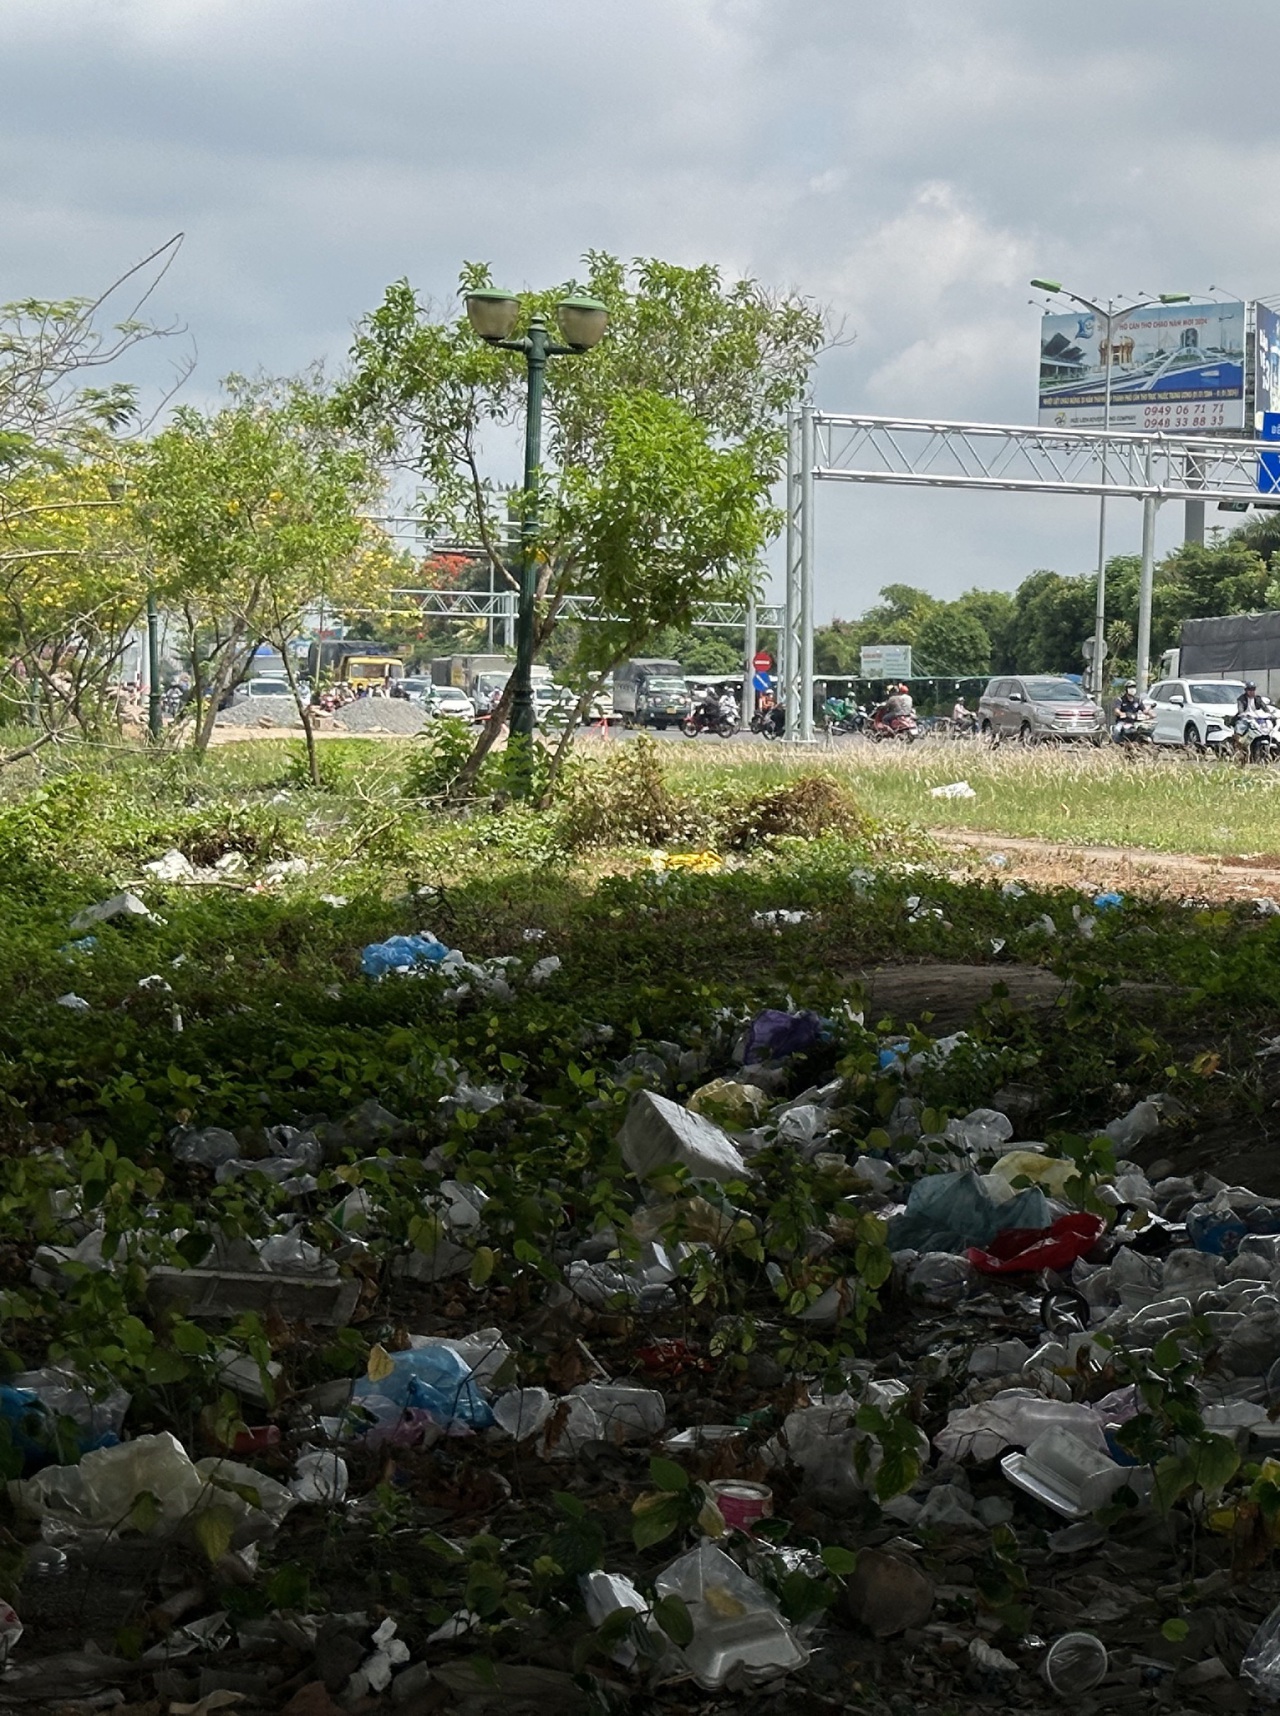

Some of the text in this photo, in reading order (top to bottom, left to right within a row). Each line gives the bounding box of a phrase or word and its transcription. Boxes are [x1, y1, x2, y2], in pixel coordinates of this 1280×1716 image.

[1144, 403, 1224, 416] 0949 06 71 71
[1175, 418, 1188, 427] 33
[1210, 416, 1224, 425] 33
